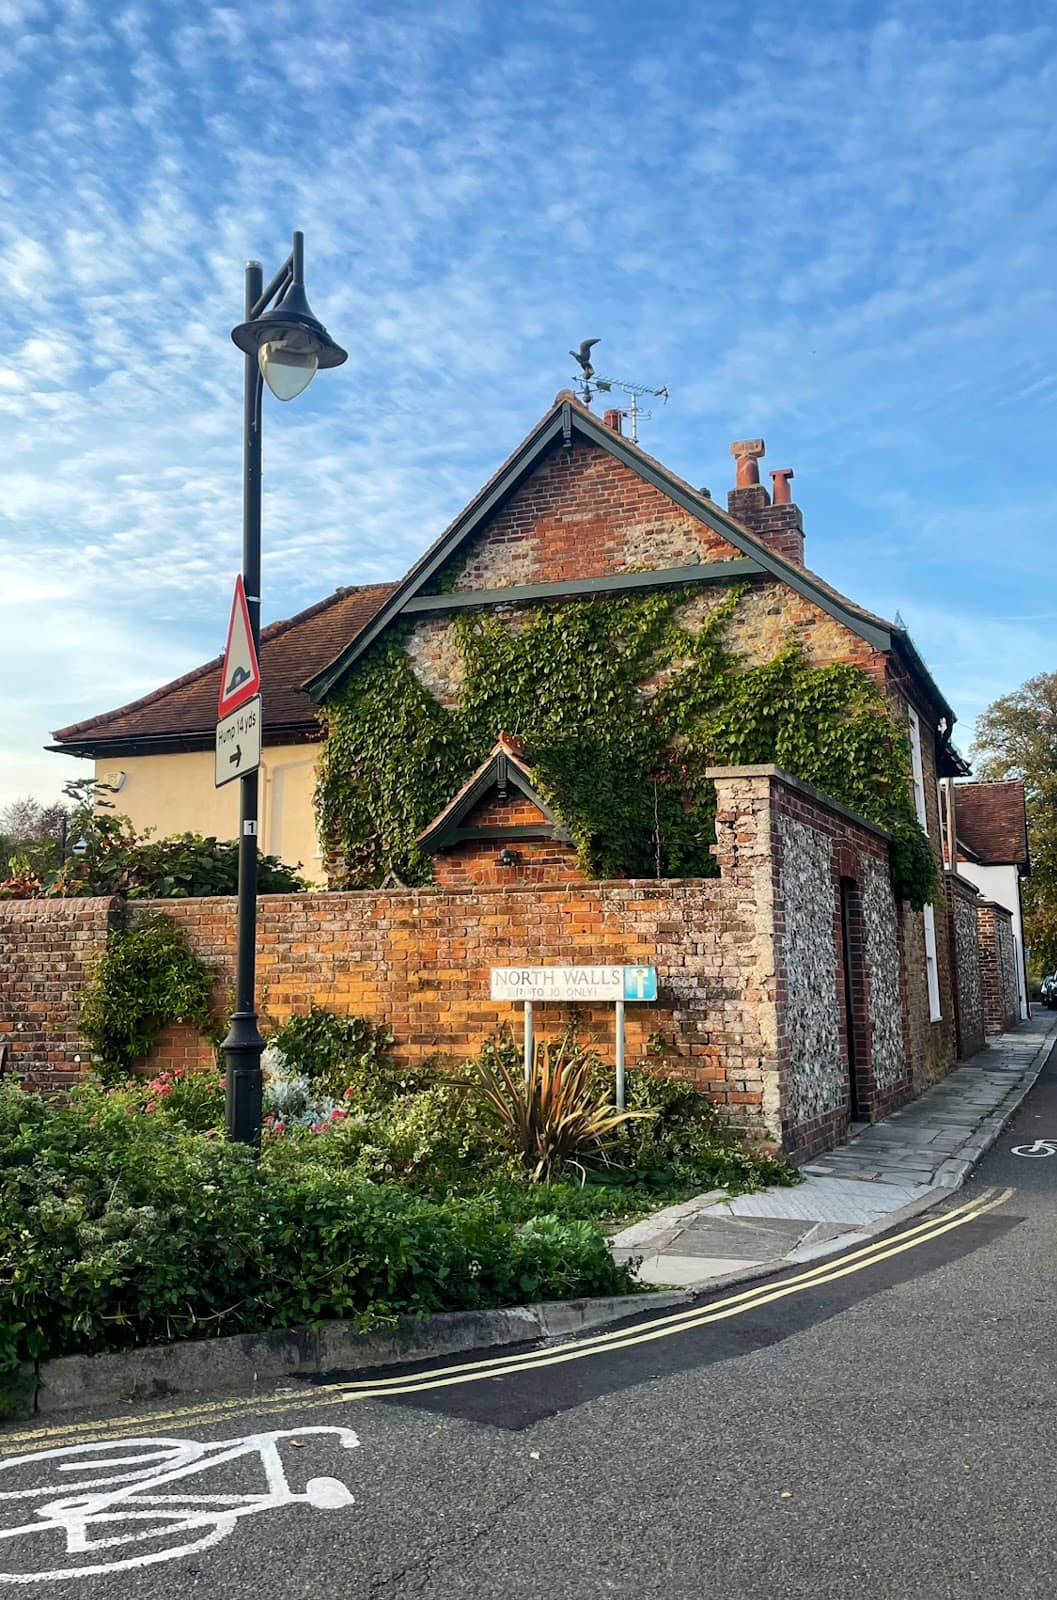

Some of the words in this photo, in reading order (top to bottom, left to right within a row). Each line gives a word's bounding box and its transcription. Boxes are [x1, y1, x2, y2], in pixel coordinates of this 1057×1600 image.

[218, 726, 236, 746] Hump
[237, 716, 244, 734] 14
[244, 711, 256, 734] yds
[495, 970, 554, 986] NORTH
[563, 969, 621, 985] WALLS
[531, 987, 544, 997] TO
